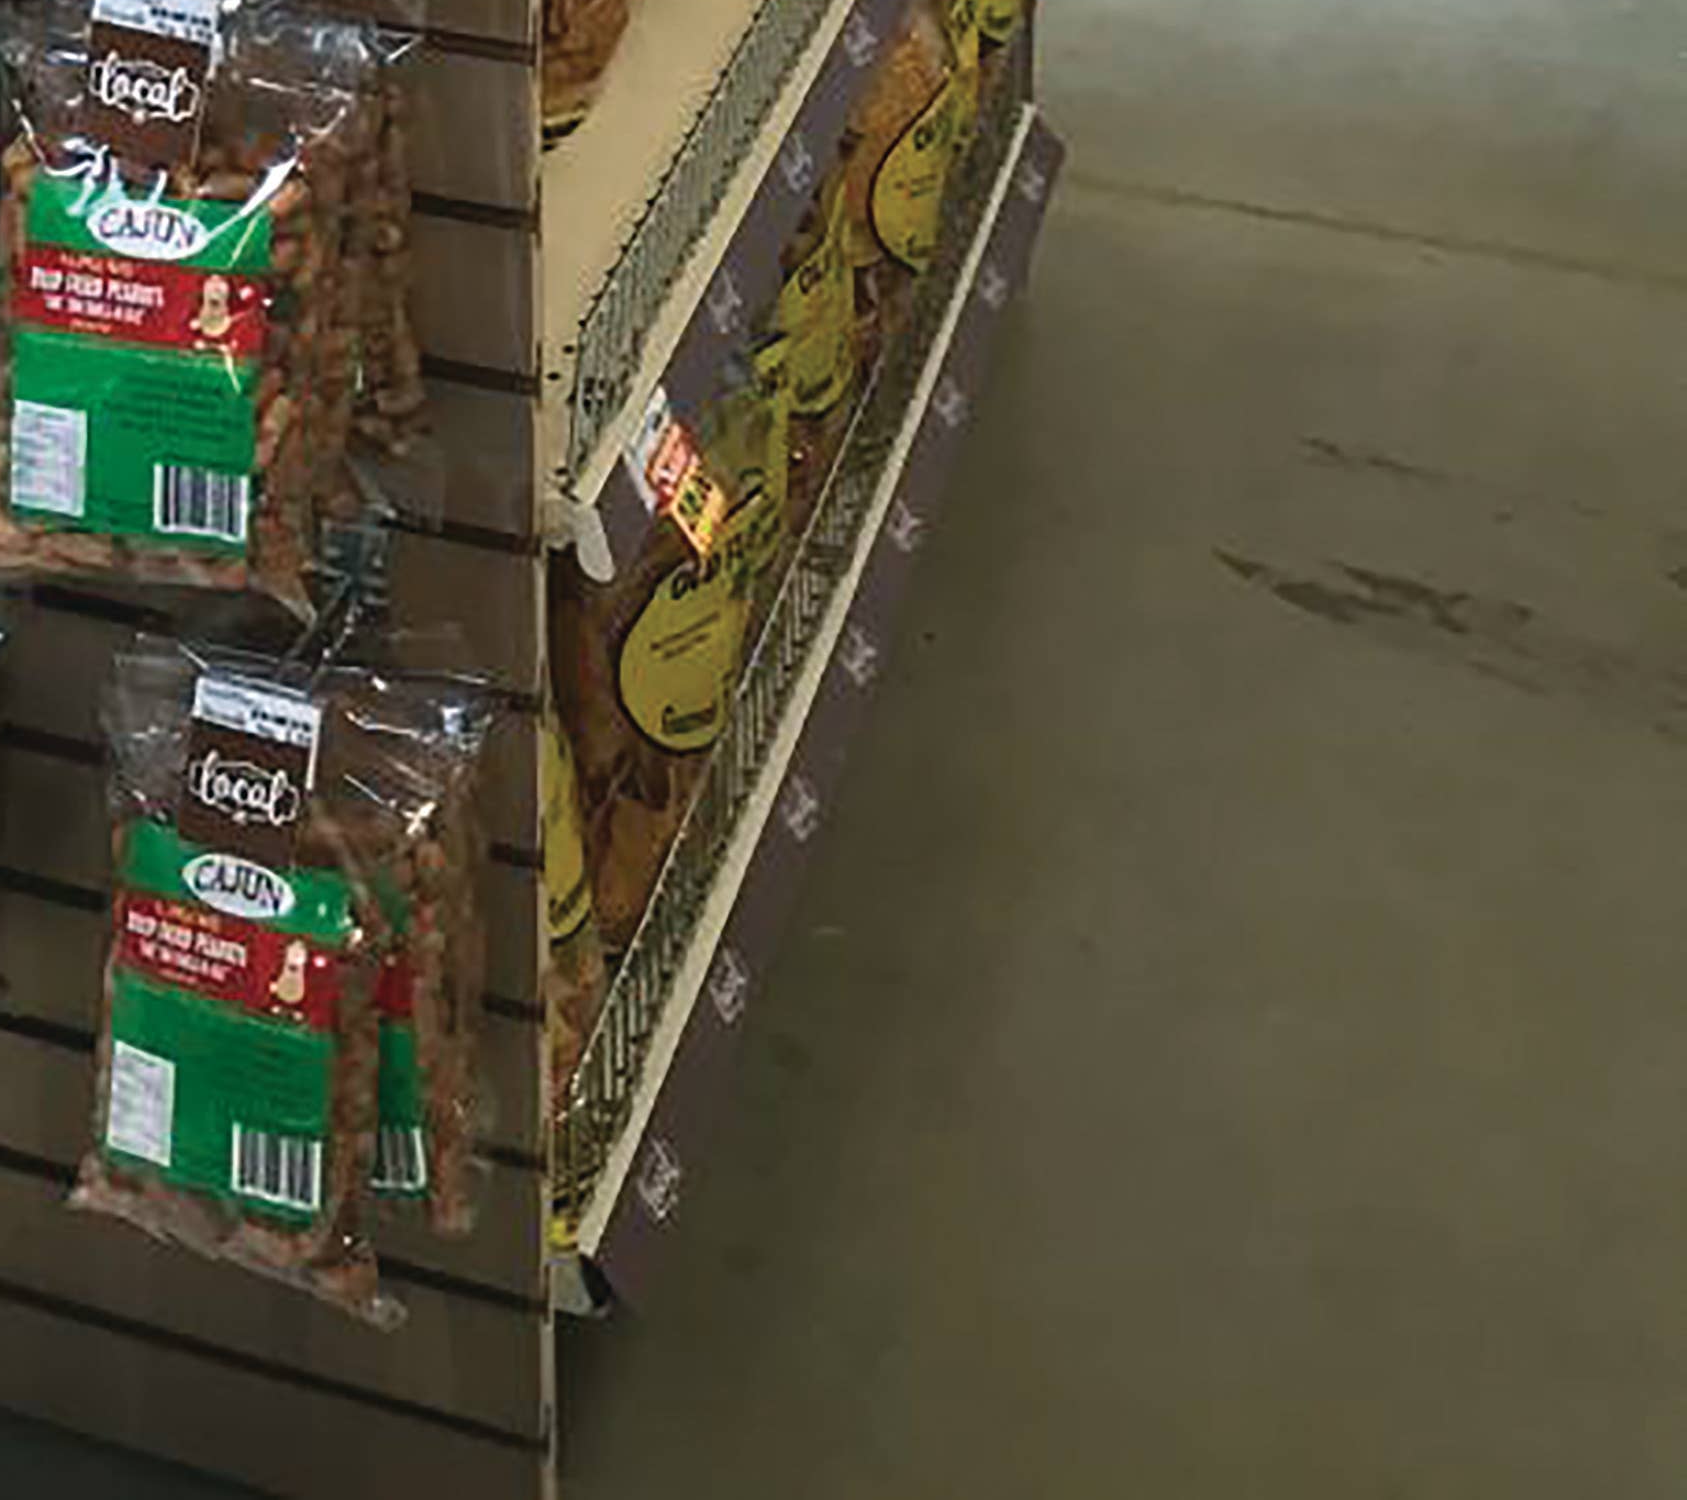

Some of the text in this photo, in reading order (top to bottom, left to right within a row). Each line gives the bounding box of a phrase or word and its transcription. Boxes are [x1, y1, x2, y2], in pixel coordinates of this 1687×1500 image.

[99, 52, 185, 119] local
[99, 208, 197, 248] CAJUN
[201, 752, 285, 825] local
[193, 862, 283, 914] CAJUN
